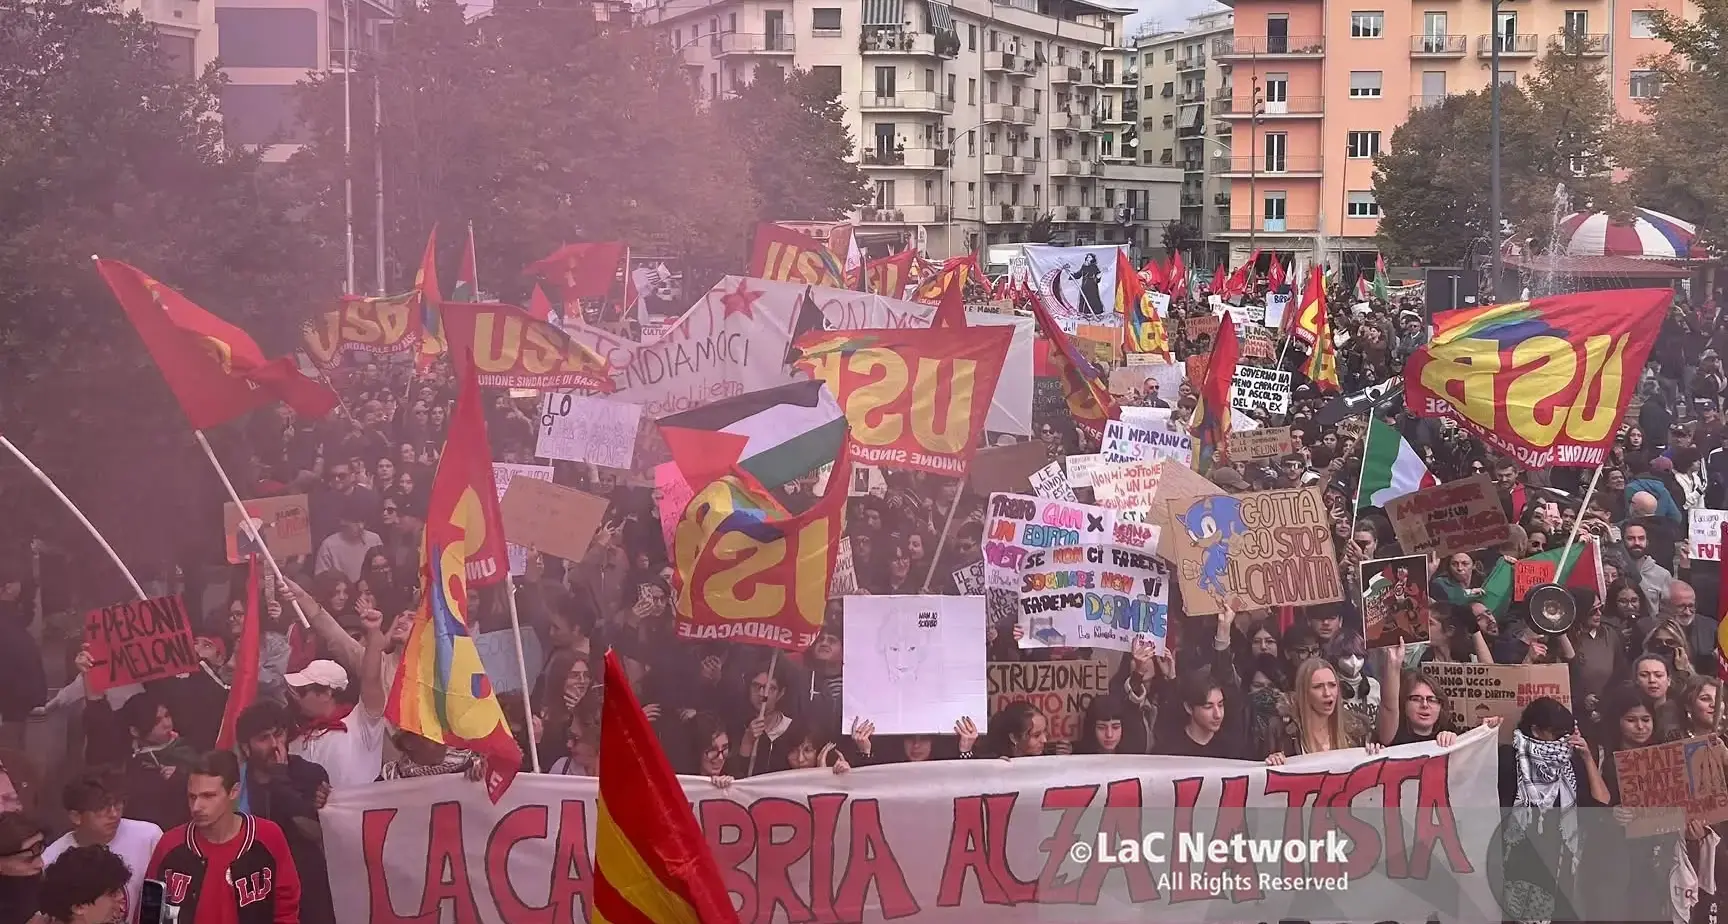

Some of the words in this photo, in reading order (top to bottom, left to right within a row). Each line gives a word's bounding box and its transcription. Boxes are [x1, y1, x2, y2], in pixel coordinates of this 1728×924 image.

[478, 375, 515, 386] UNIONE
[562, 374, 572, 385] DI
[574, 376, 600, 387] BASE
[1240, 366, 1277, 382] GOVERNO
[1278, 371, 1290, 382] HA
[1237, 388, 1246, 397] DI
[1248, 390, 1282, 402] ASCOLTO
[1232, 397, 1249, 408] DEL
[1268, 401, 1283, 412] EX
[1107, 424, 1123, 440] NI
[1090, 471, 1111, 488] NON
[1126, 478, 1140, 493] UN
[1239, 489, 1319, 528] GOTTA
[1242, 527, 1274, 559] GO
[1273, 526, 1331, 558] STOP
[1024, 550, 1046, 570] SE
[1052, 546, 1084, 565] NON
[1020, 570, 1096, 593] SOGNARE
[1101, 571, 1135, 595] NON
[1226, 557, 1249, 594] IL
[1245, 556, 1340, 605] CAROVITA
[1020, 592, 1085, 616] FAREMO
[1084, 592, 1169, 638] DORMIRE
[986, 662, 1097, 696] STRUZIONE
[1422, 666, 1440, 676] OH
[1443, 666, 1463, 676] MIO
[1465, 676, 1502, 687] UCCISO
[1517, 683, 1561, 697] BRUTTI
[362, 801, 486, 924] LA
[484, 793, 922, 924] CABRIA
[1168, 775, 1267, 905] LA
[1264, 753, 1474, 881] TESTA
